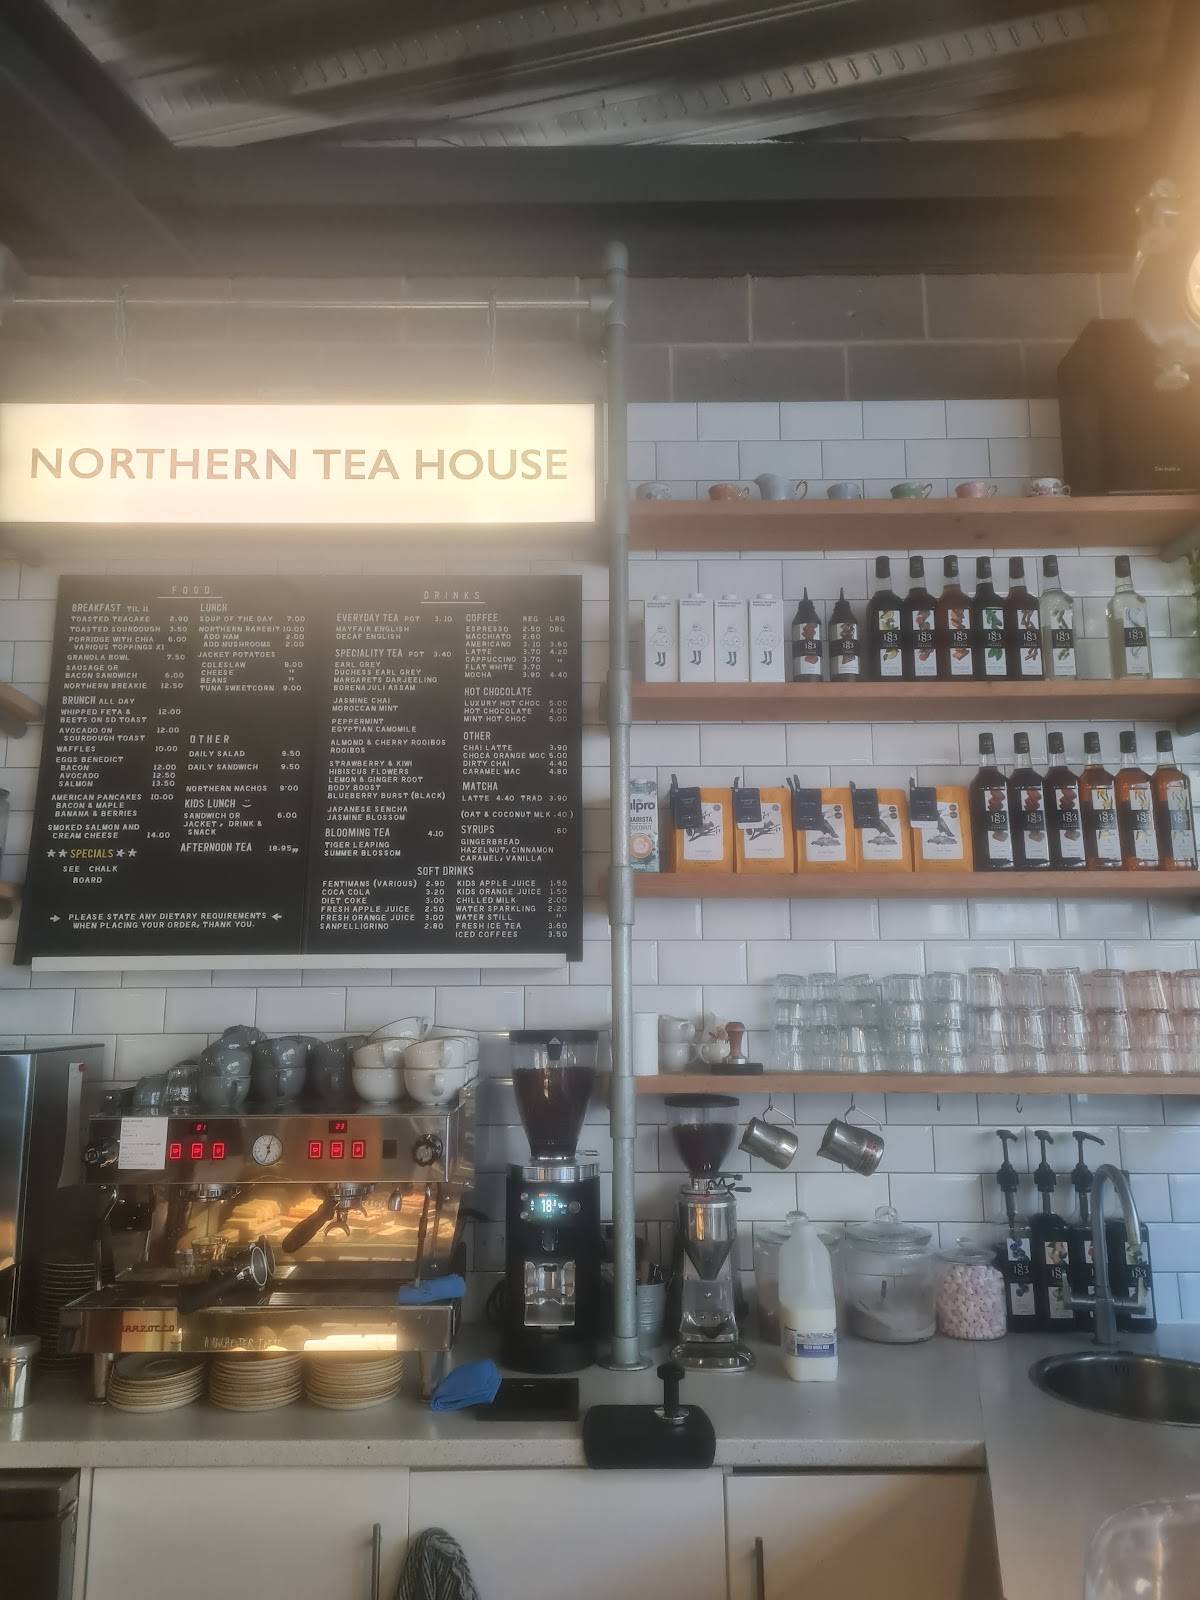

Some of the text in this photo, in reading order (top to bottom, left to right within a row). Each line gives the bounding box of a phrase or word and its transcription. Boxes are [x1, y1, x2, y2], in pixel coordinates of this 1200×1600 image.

[30, 448, 568, 480] NORTHERN TEA HOUSE
[72, 604, 120, 612] BREAKFAST
[200, 604, 227, 612] LUNCH
[336, 614, 398, 622] EVERYDAY TEA
[466, 614, 498, 622] COFFEE
[336, 649, 403, 657] SPECIALITY TEA
[465, 688, 532, 696] HOT CHOCOLATE
[62, 696, 96, 704] BRUNCH
[190, 735, 229, 743] OTHER
[464, 732, 490, 740] OTHER
[462, 782, 498, 791] MATCHA
[411, 792, 445, 800] (BLACK)
[185, 799, 235, 808] KIDS LUNCH
[325, 828, 370, 837] BLOOMING
[373, 828, 390, 836] TEA
[461, 825, 494, 834] SYRUPS
[181, 843, 252, 852] AFTERNOON TEA
[71, 849, 113, 858] SPECIALS
[417, 867, 474, 876] SOFT DRINKS
[373, 880, 417, 888] (VARIOUS)
[68, 913, 104, 921] PLEASE
